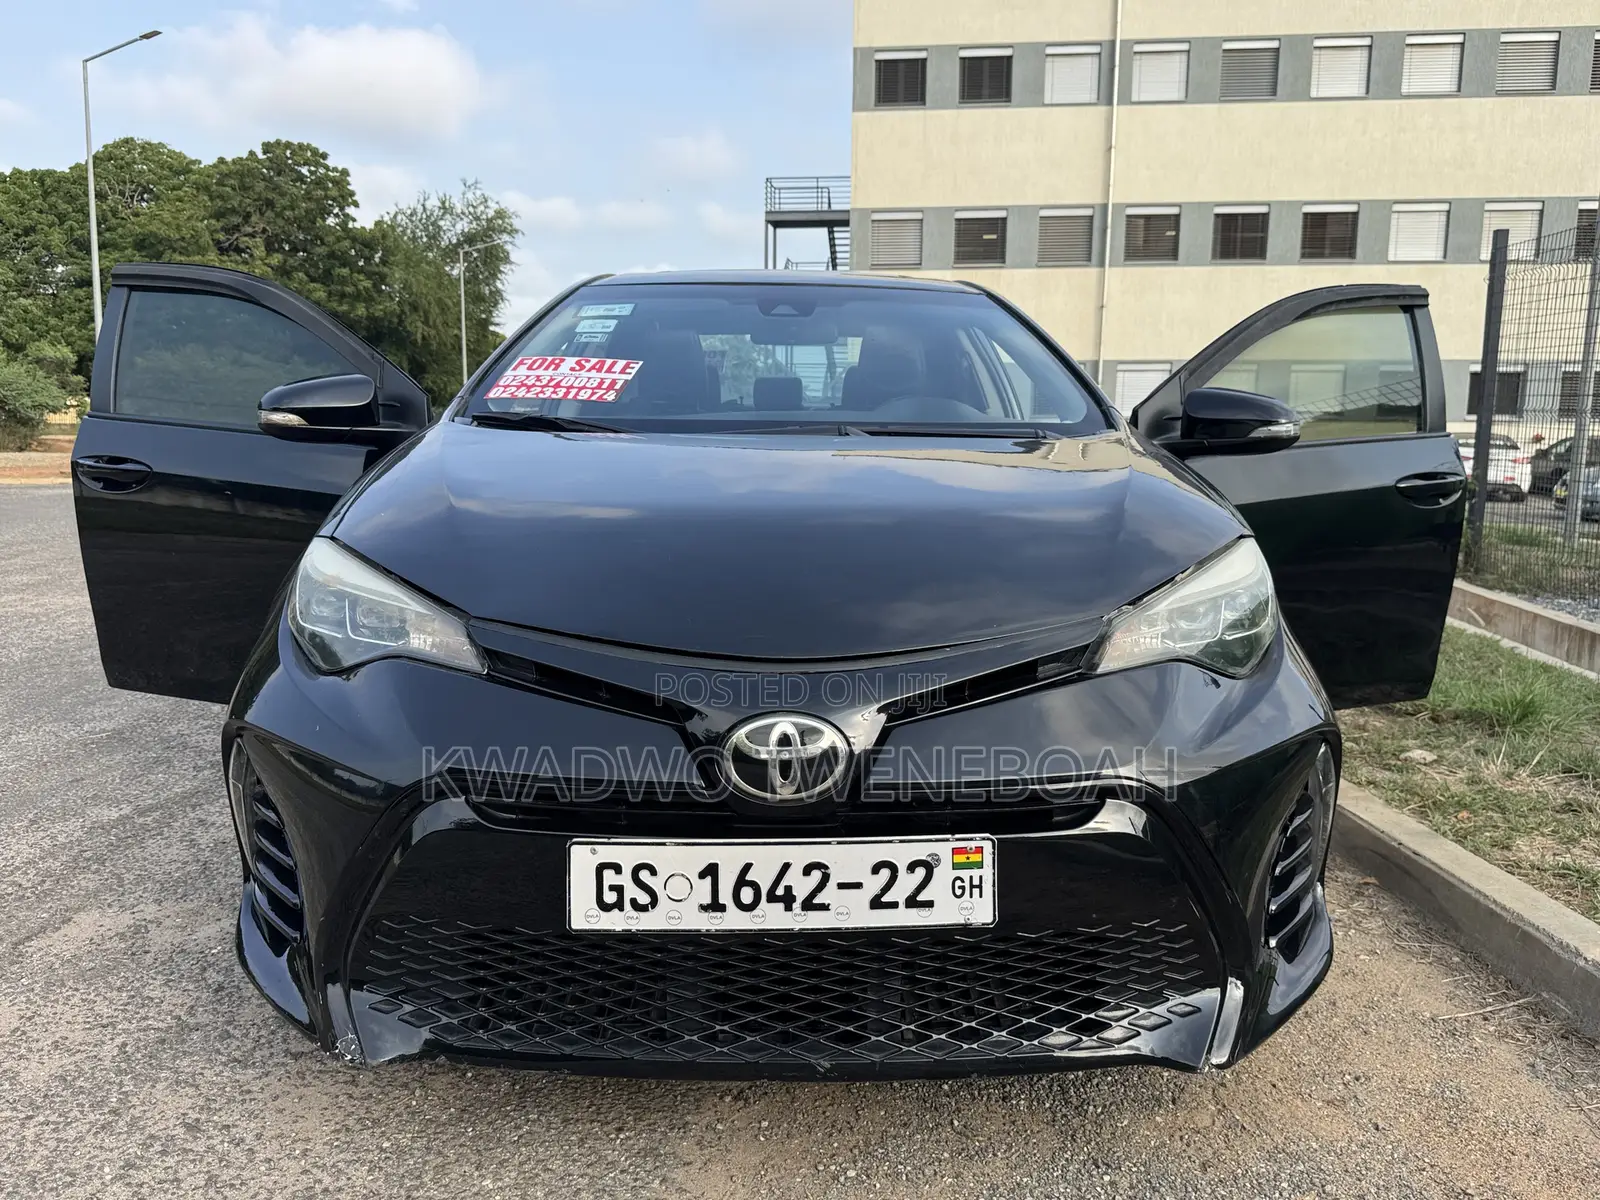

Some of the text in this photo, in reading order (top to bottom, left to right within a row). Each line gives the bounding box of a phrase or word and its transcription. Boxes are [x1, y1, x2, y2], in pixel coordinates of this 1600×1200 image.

[511, 357, 639, 375] FOR SALE
[498, 375, 624, 389] 0243700811
[488, 386, 616, 401] 0242331974
[595, 859, 935, 912] GS 1642-22
[951, 875, 984, 899] GH
